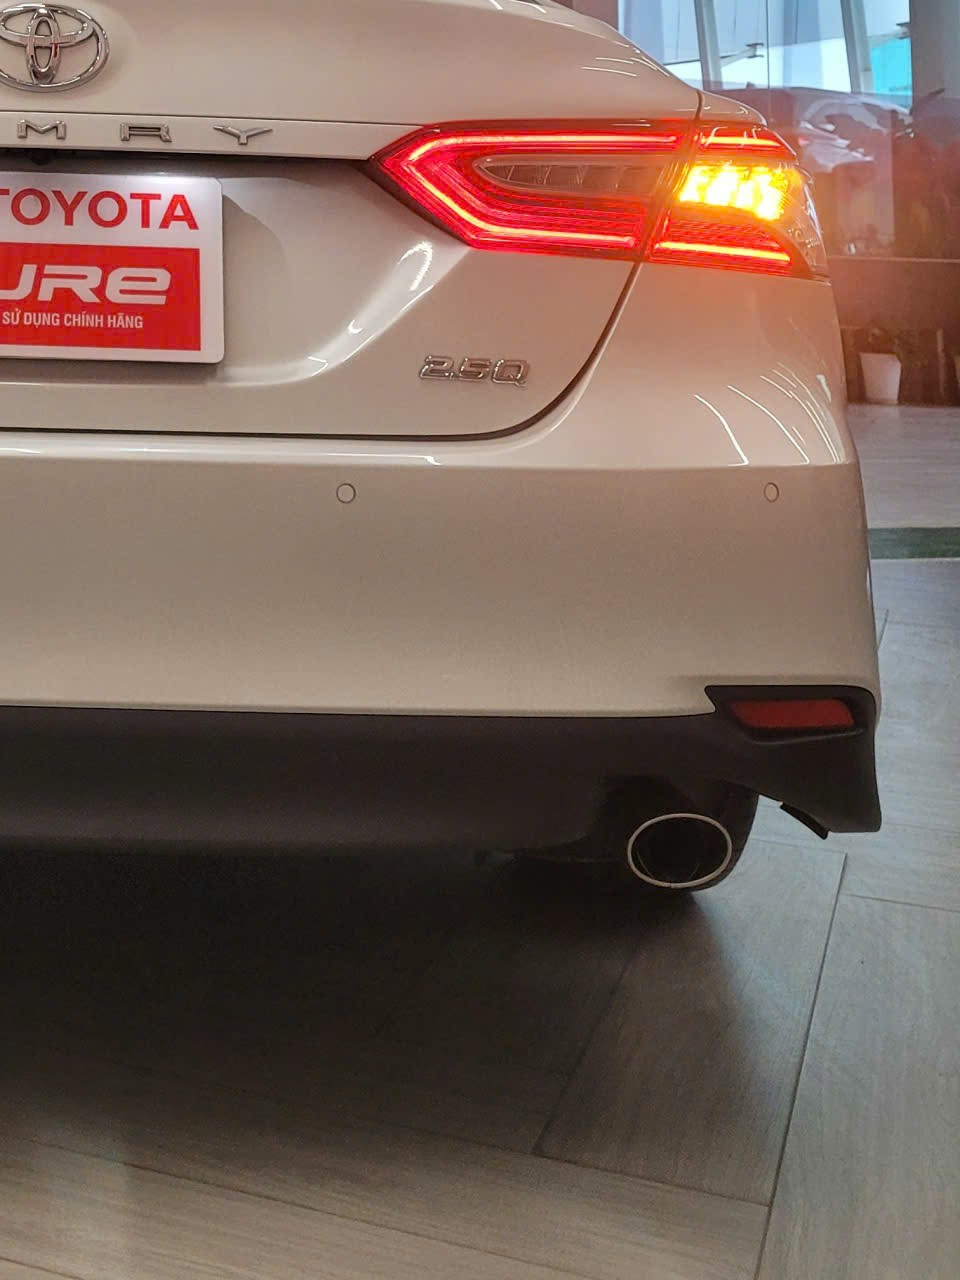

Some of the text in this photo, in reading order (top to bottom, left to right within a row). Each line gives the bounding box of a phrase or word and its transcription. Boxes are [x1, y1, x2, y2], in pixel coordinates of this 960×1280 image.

[2, 308, 21, 325] SỬ
[24, 312, 60, 329] DỤNG
[64, 310, 104, 328] CHÍNH
[107, 312, 144, 329] HÃNG
[419, 355, 530, 389] 2.5Q
